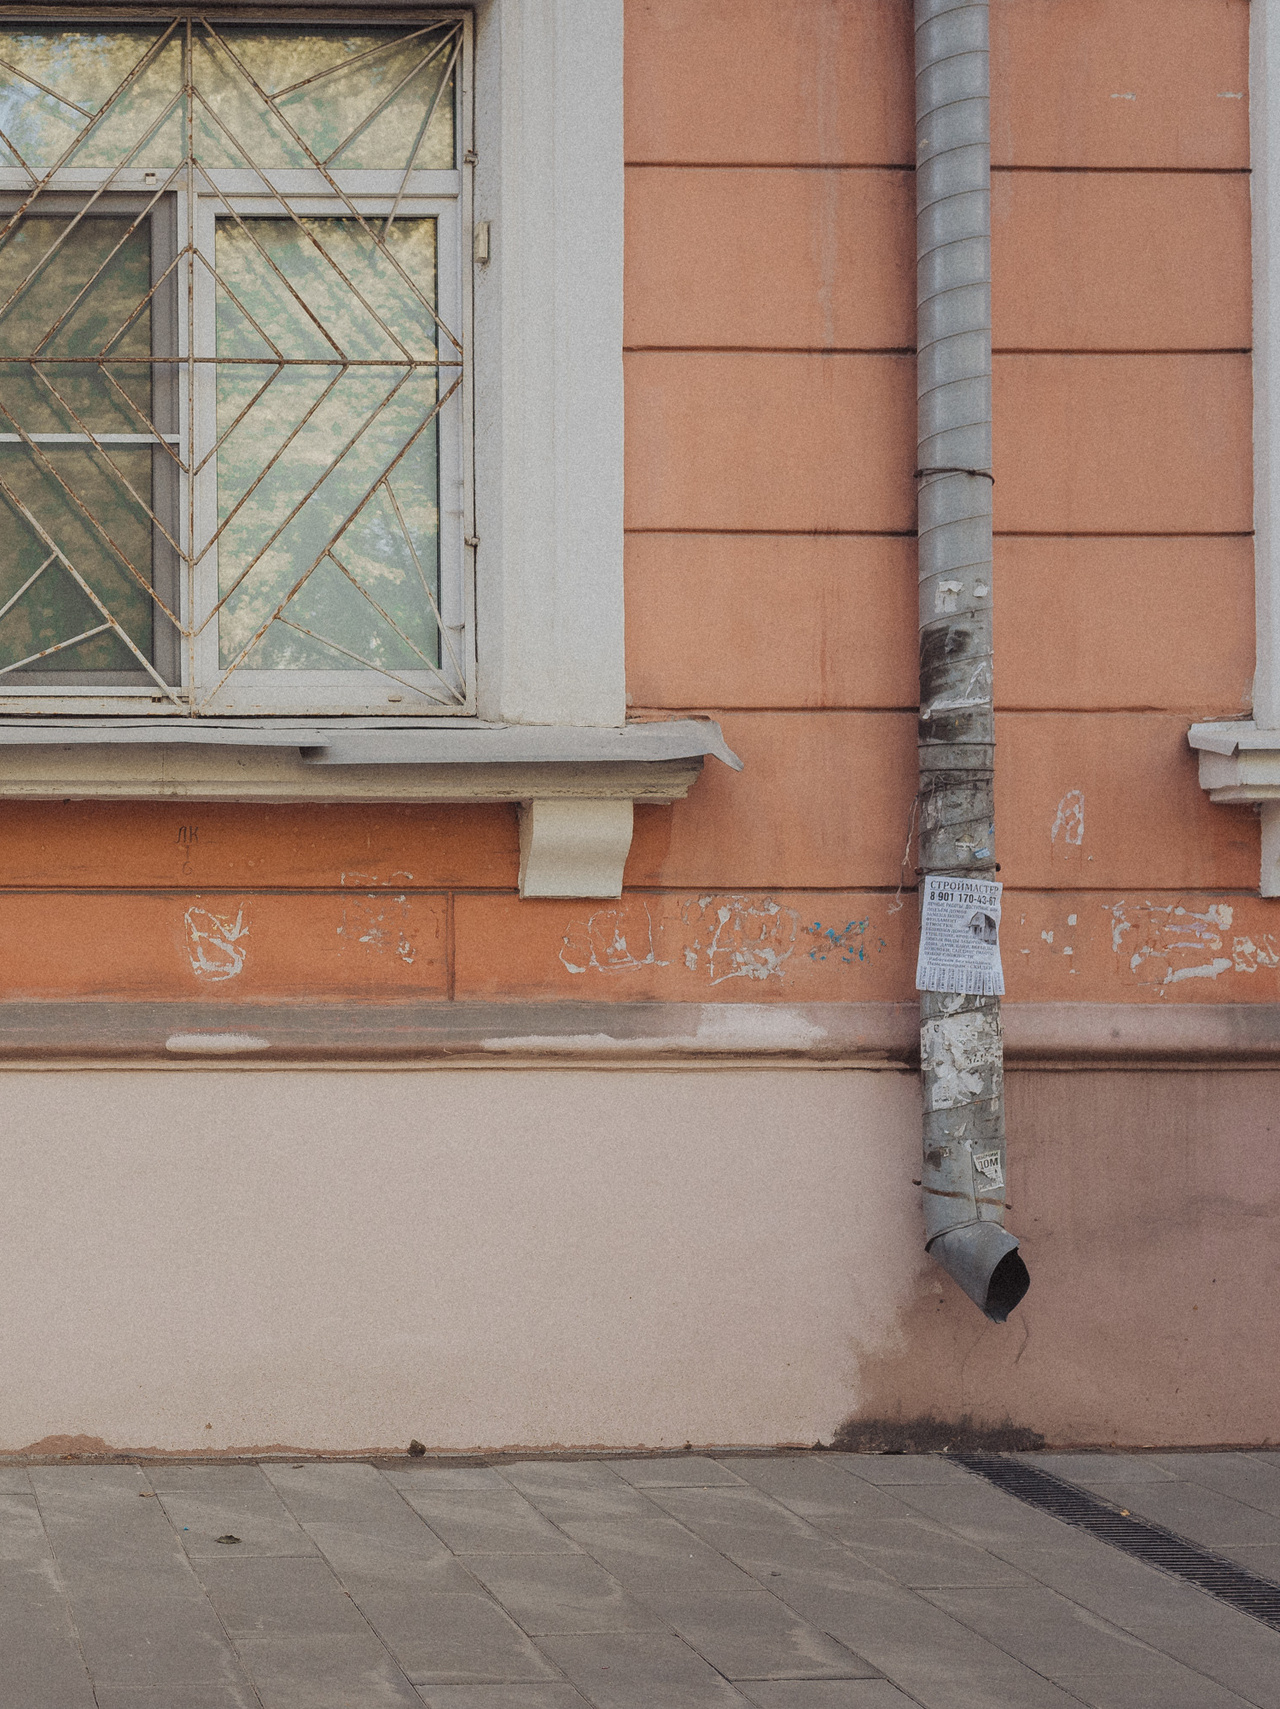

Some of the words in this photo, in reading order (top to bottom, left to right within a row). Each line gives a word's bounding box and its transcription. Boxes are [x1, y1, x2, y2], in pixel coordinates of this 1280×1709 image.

[931, 880, 999, 894] СТРОЙМАСТЕР
[930, 892, 935, 900] 8
[938, 892, 953, 902] 901
